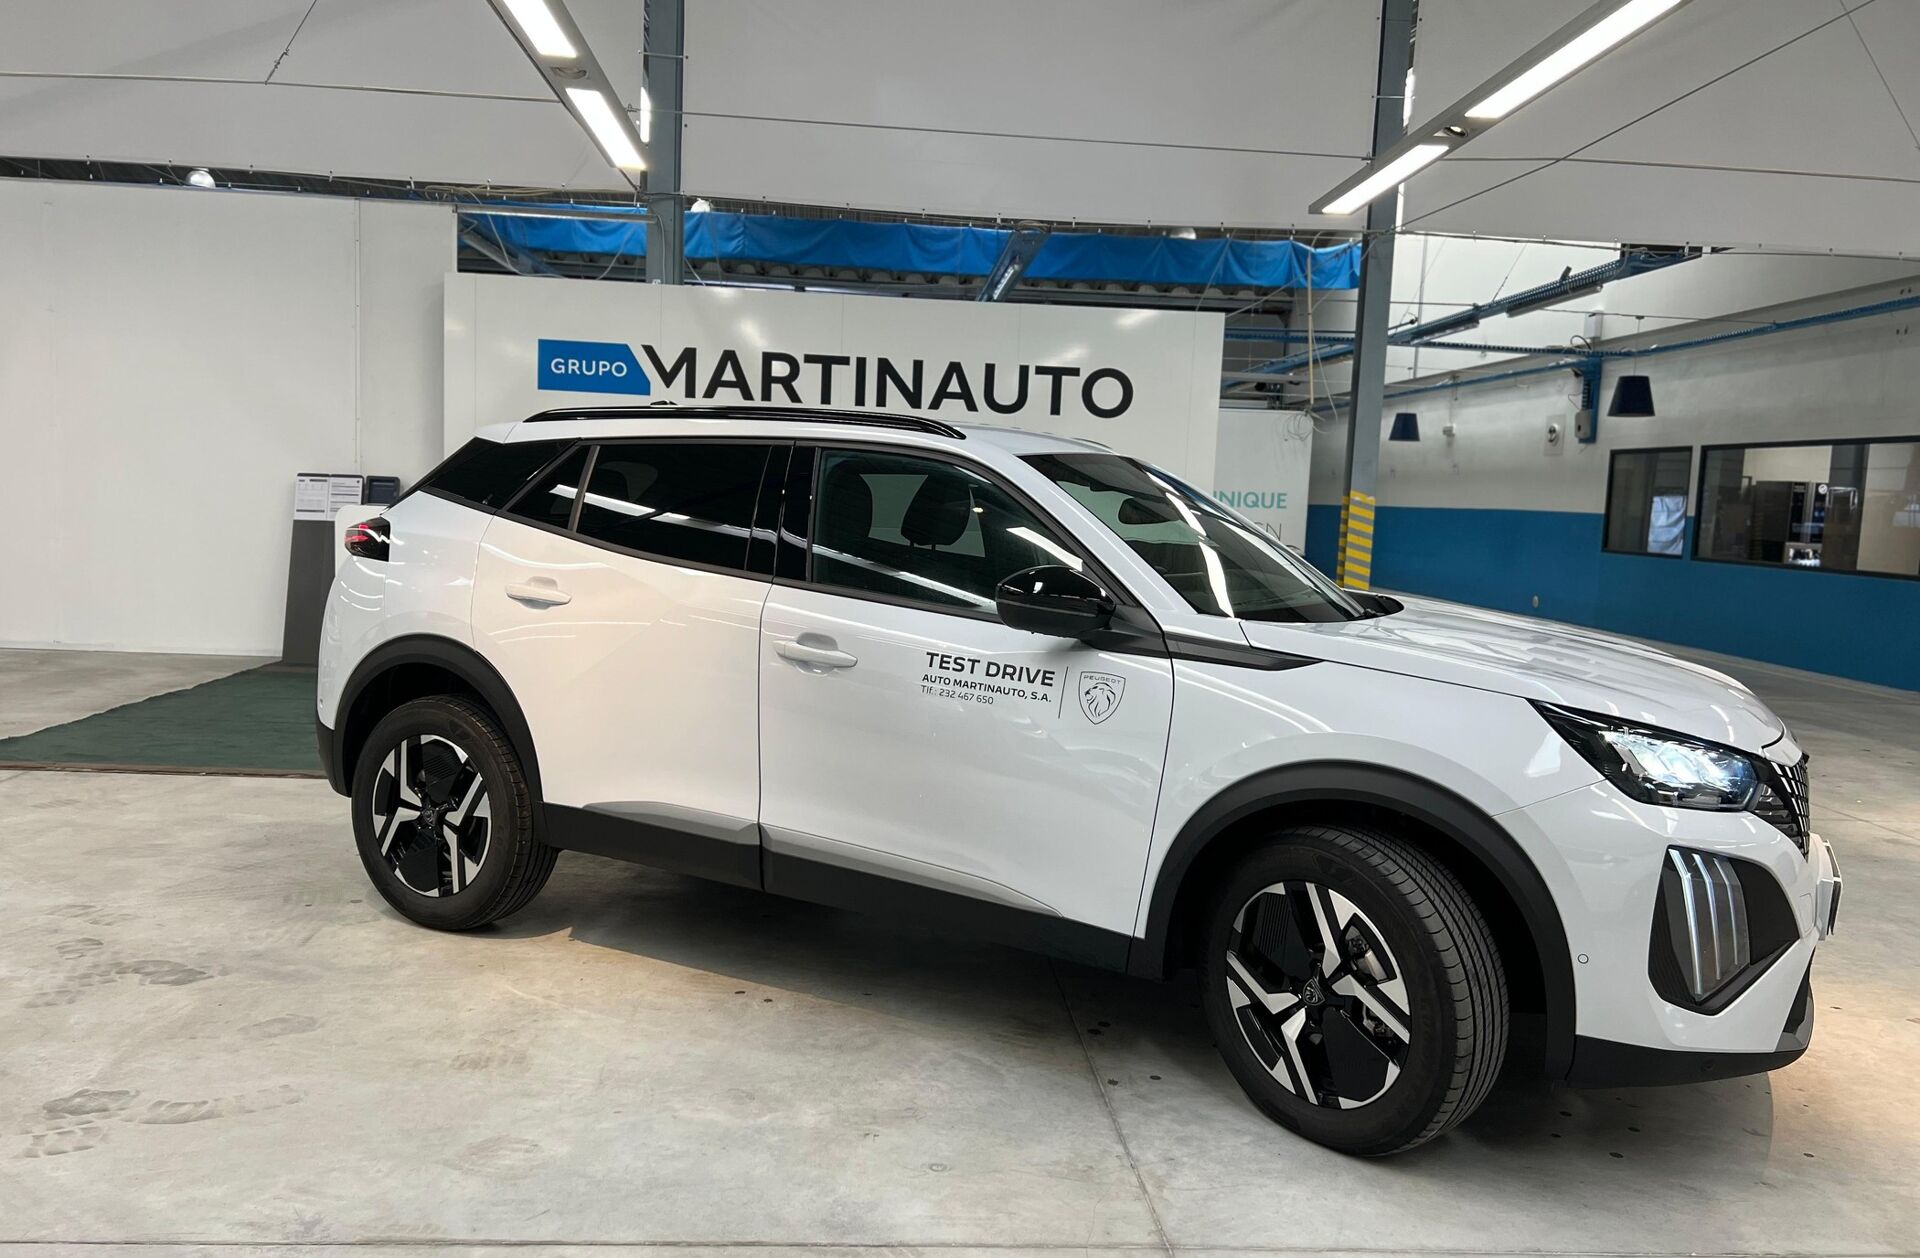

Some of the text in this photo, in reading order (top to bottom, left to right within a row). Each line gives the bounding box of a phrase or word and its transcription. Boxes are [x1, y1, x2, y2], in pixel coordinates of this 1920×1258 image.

[550, 344, 1135, 419] GRUPO MARTINAUTO
[926, 651, 1056, 687] TEST DRIVE
[1083, 674, 1121, 685] PEUGEOT
[921, 674, 1052, 703] AUTO MARTINAUTO, S.A.
[939, 688, 956, 699] 232
[957, 692, 975, 702] 467
[976, 694, 994, 705] 650
